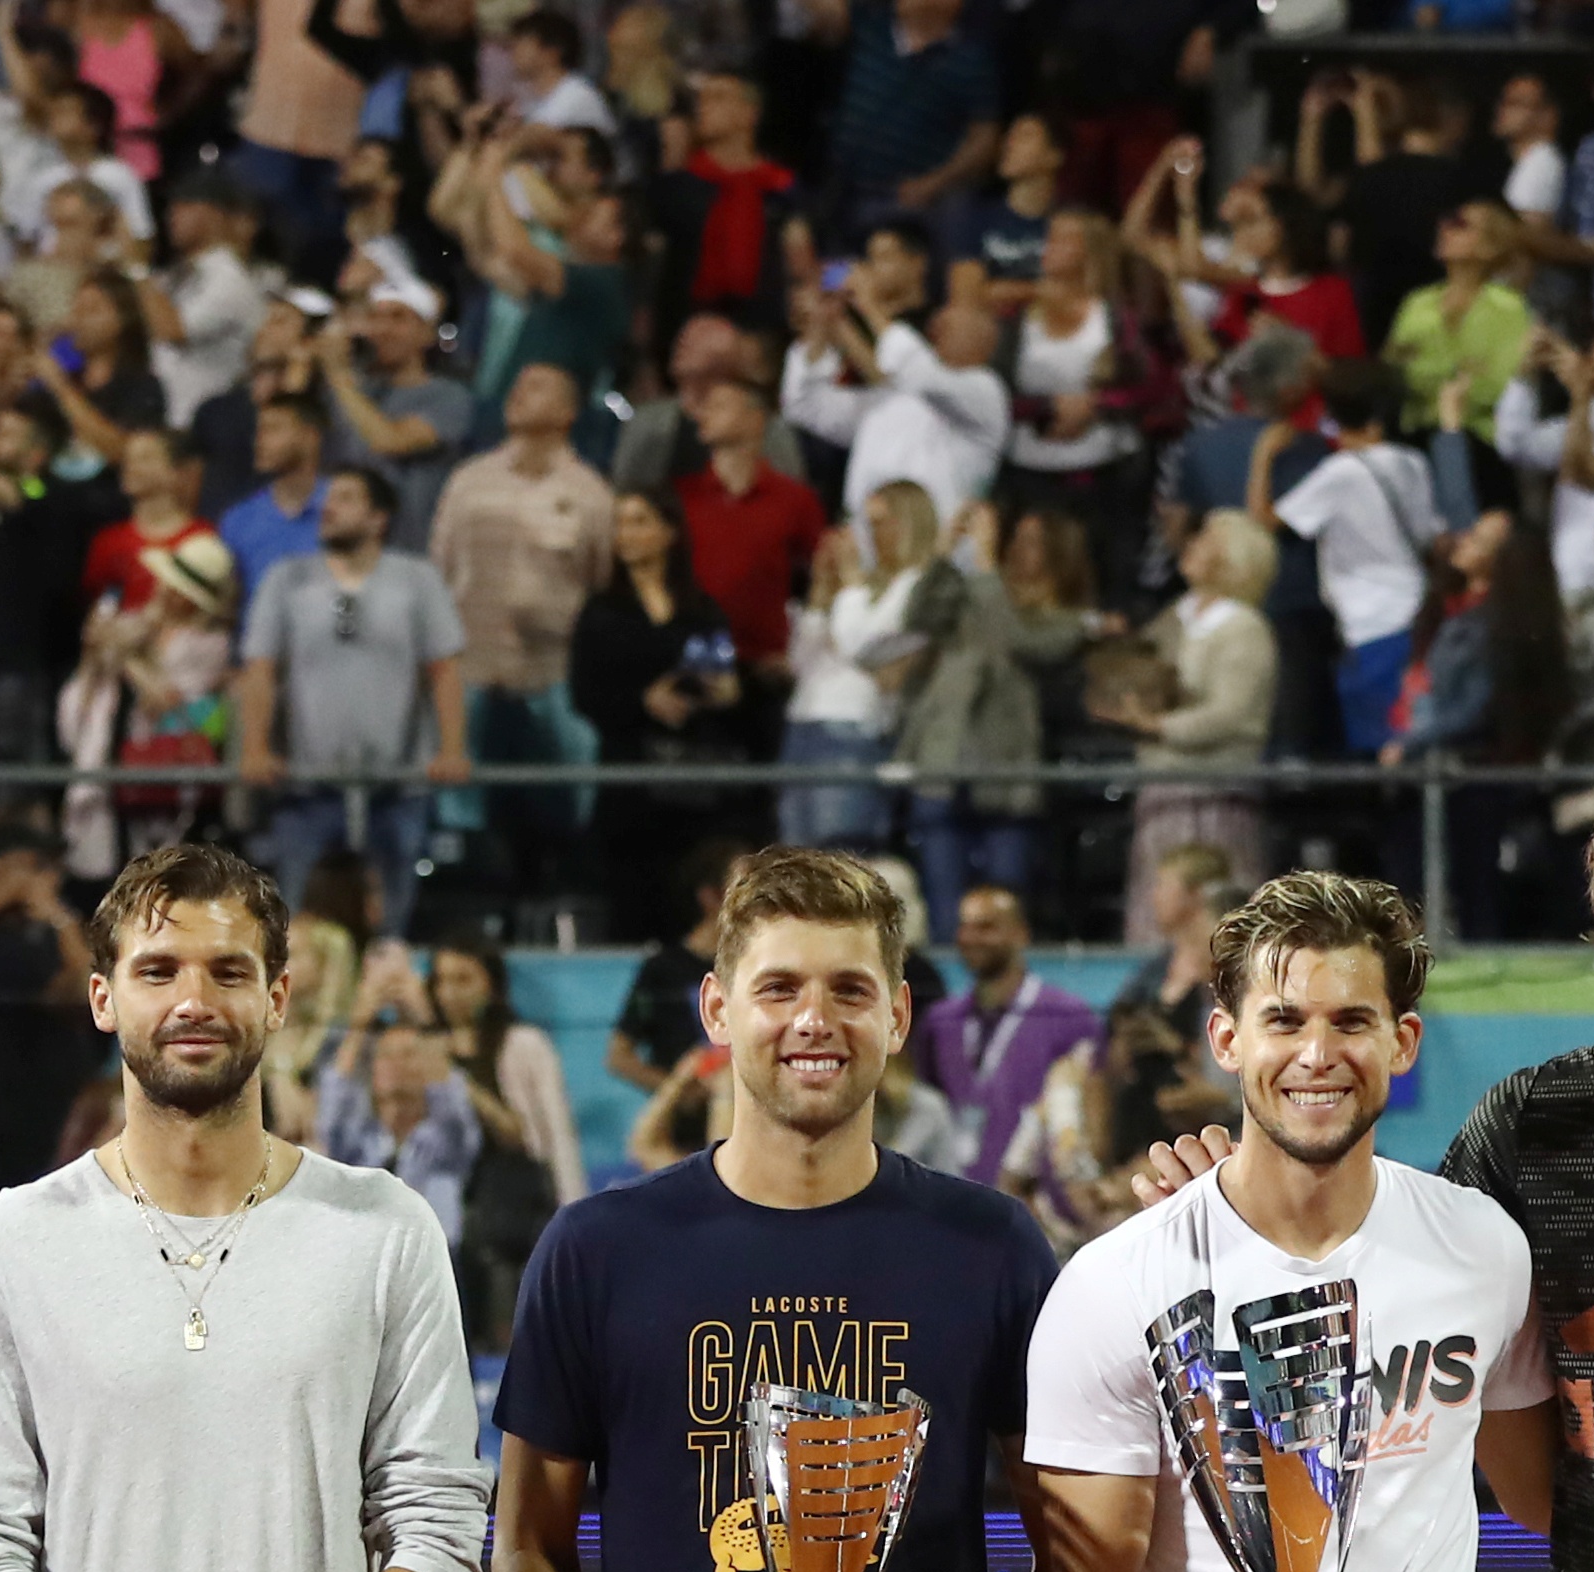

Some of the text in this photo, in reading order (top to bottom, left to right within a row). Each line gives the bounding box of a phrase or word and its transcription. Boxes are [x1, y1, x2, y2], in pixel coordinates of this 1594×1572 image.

[750, 1297, 849, 1314] LACOSTE
[688, 1320, 909, 1424] GAME
[1372, 1335, 1477, 1418] NIS
